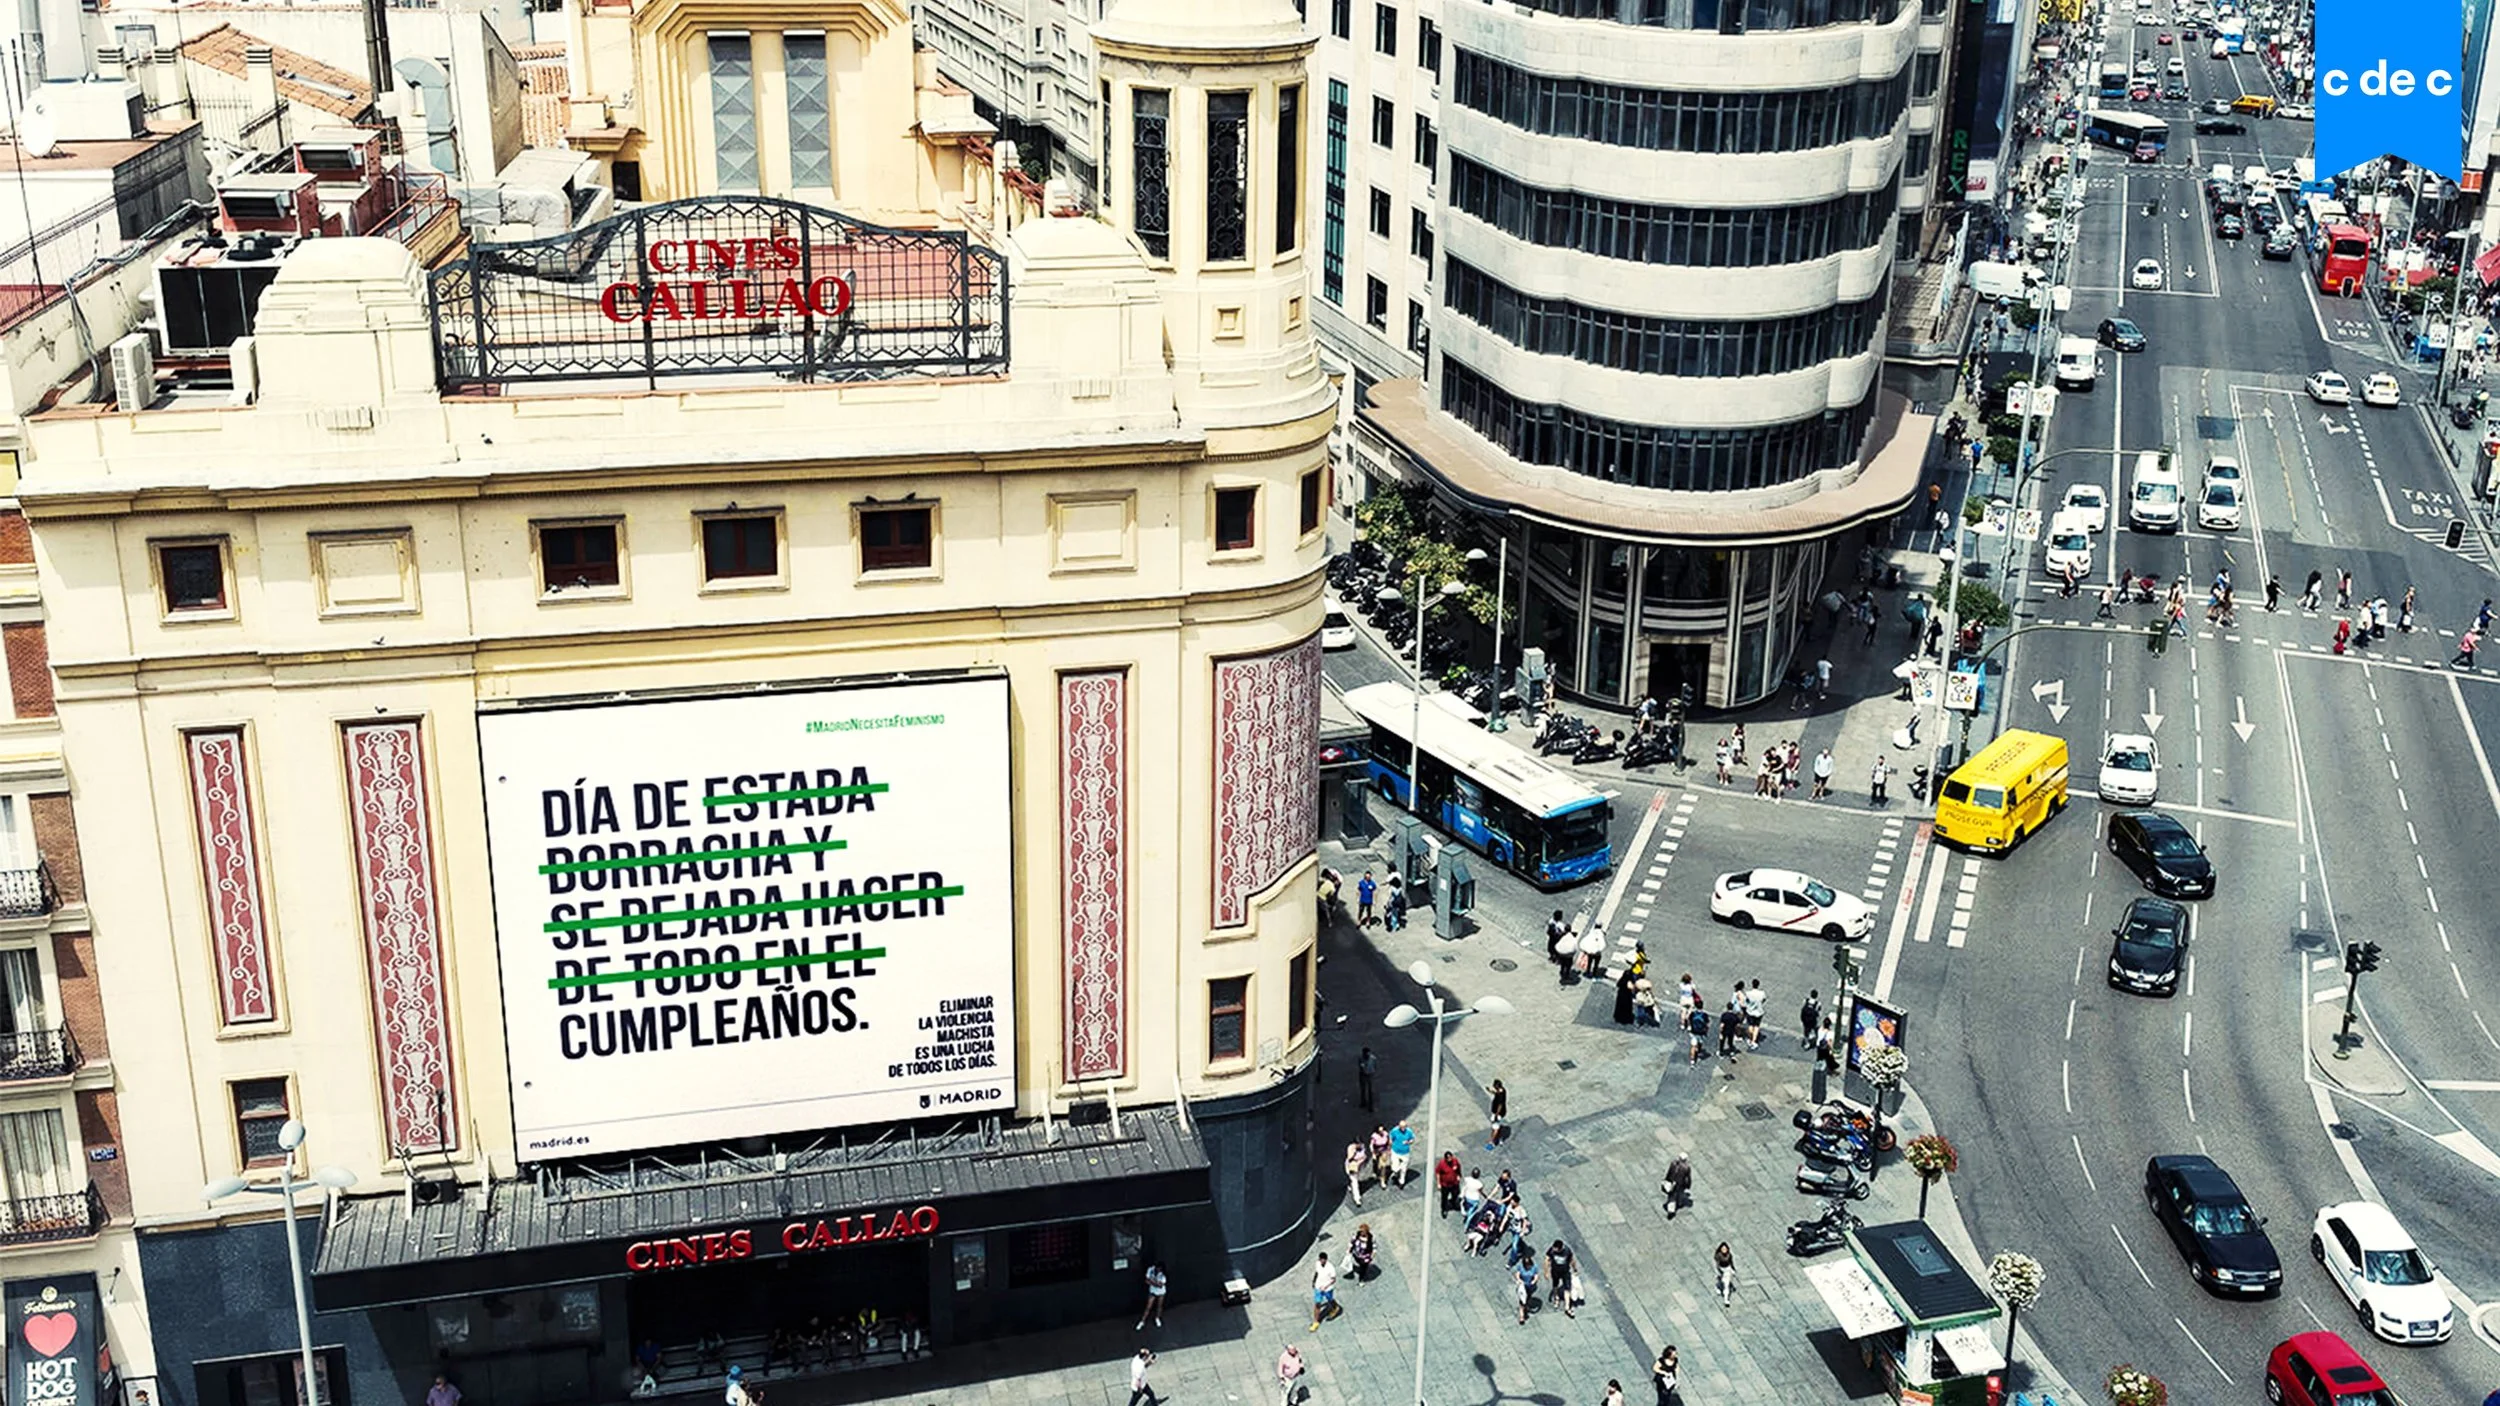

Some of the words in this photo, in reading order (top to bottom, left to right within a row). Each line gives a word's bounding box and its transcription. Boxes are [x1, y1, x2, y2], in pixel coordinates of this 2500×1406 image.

[1947, 129, 1969, 194] REX
[649, 236, 801, 273] CINES
[601, 275, 851, 323] CALLAO
[2334, 319, 2372, 330] TAXI
[2337, 328, 2370, 338] BUS
[2401, 488, 2453, 505] TAXI
[2410, 503, 2455, 519] BUS
[541, 777, 621, 838] DÍA
[633, 780, 691, 831] DE
[703, 766, 876, 825] ESTABA
[546, 829, 793, 895] BORRACHA
[803, 825, 833, 872] Y
[551, 898, 608, 950] SE
[621, 885, 789, 944] DEJABA
[803, 871, 945, 928] HACER
[555, 956, 614, 1006] DE
[624, 944, 742, 998] TODO
[755, 937, 811, 987] EN
[824, 932, 877, 978] EL
[939, 995, 994, 1013] ELIMINAR
[558, 983, 870, 1060] CUMPLEAÑOS.
[918, 1016, 933, 1030] LA
[935, 1010, 994, 1028] VIOLENCIA
[936, 1025, 994, 1043] MACHISTA
[915, 1046, 930, 1060] ES
[932, 1043, 955, 1058] UNA
[957, 1039, 995, 1056] LUCHA
[888, 1063, 904, 1078] DE
[906, 1060, 943, 1076] TODOS
[945, 1057, 966, 1072] LOS
[968, 1053, 997, 1069] DÍAS.
[939, 1088, 1001, 1104] MADRID
[529, 1136, 590, 1149] madrid.es
[626, 1229, 753, 1271] CINES
[781, 1205, 939, 1251] CALLAO
[26, 1357, 78, 1381] HOT
[26, 1378, 77, 1400] DOG
